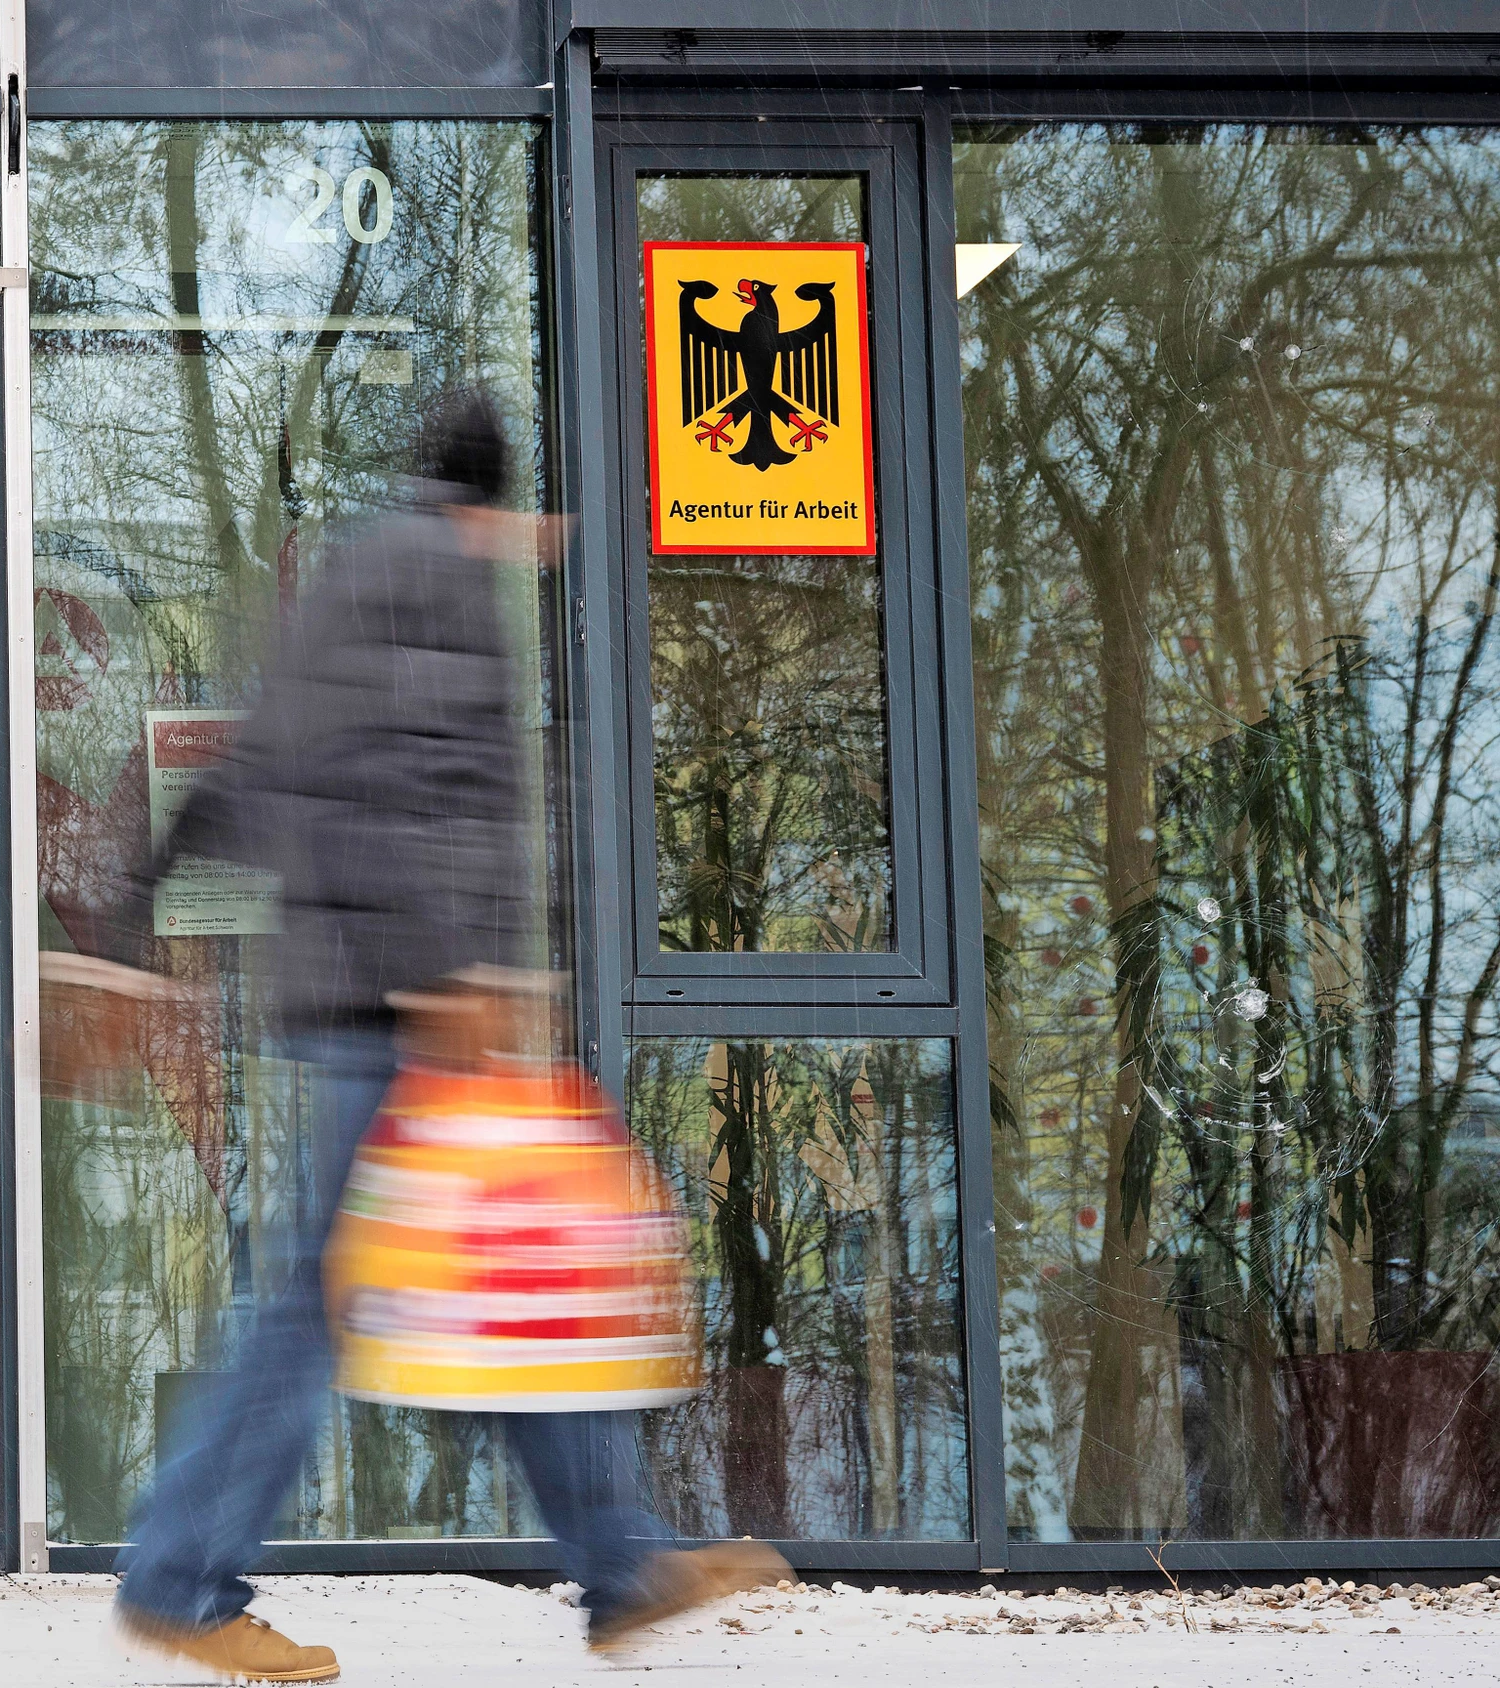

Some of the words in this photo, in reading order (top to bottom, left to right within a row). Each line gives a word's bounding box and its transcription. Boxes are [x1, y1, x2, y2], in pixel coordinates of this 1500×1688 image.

[283, 166, 394, 244] 20
[669, 500, 753, 522] Agentur
[760, 500, 788, 518] für
[794, 501, 858, 519] Arbeit
[167, 733, 219, 747] Agentur
[162, 770, 207, 779] Persönli
